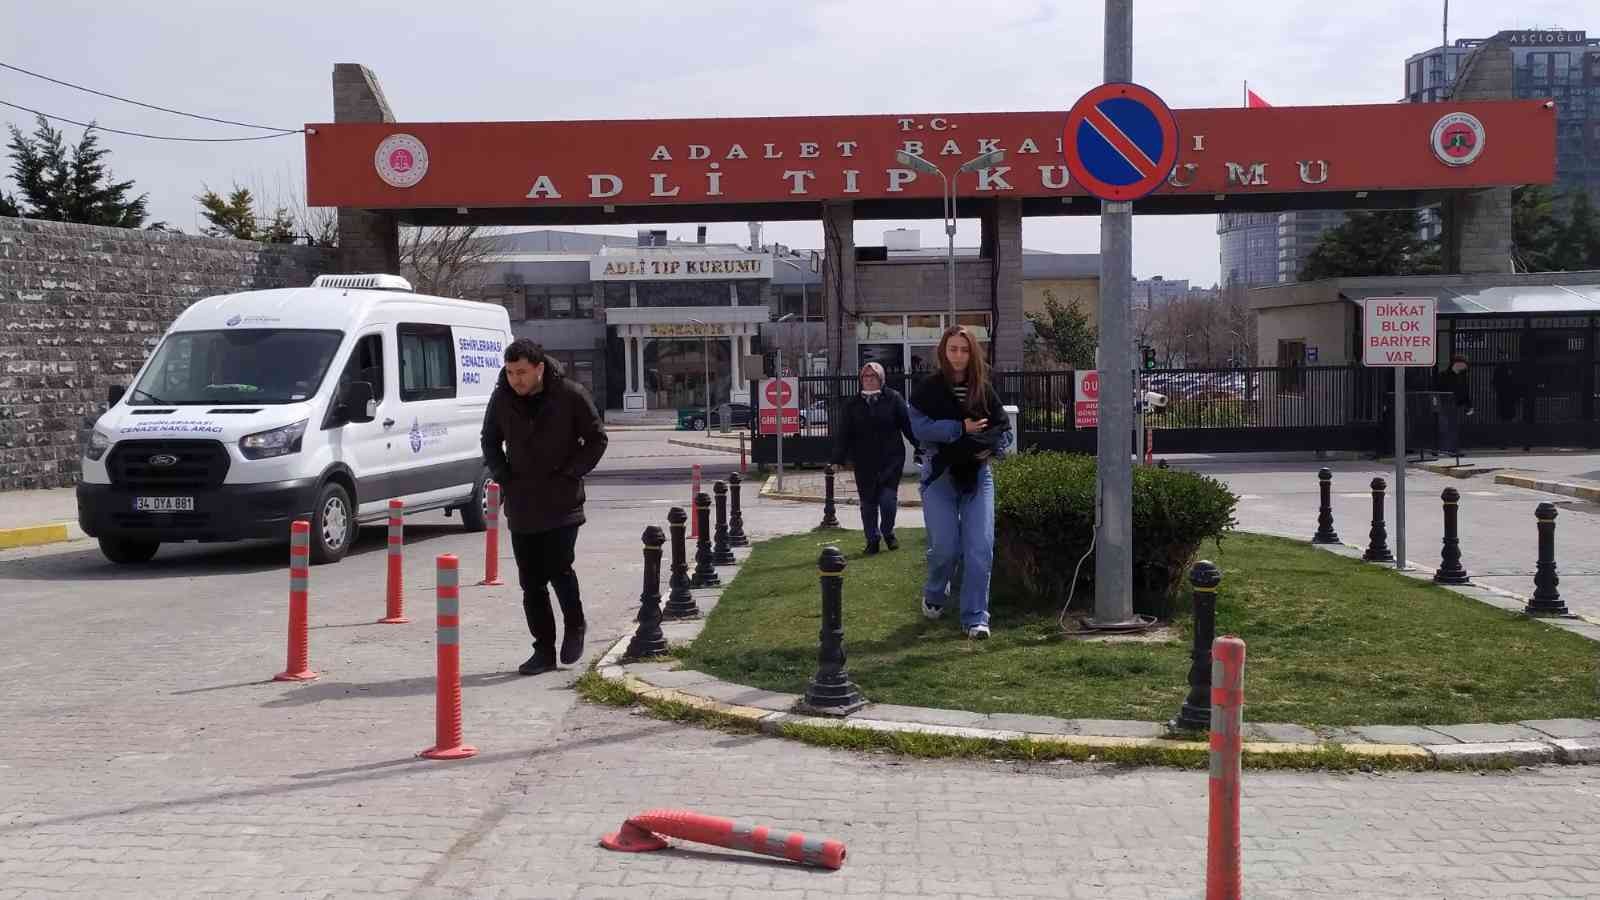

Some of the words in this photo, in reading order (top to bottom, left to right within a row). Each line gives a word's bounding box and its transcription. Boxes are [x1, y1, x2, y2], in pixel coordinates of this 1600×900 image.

[898, 118, 958, 131] T.C.
[651, 141, 857, 161] ADALET
[903, 135, 1205, 156] BAKAI
[525, 162, 724, 198] ADLİ
[783, 169, 917, 194] TIP
[975, 160, 1329, 191] KUUMU
[604, 259, 646, 275] ADLİ
[651, 260, 681, 275] TIP
[687, 259, 761, 275] KURUMU
[1376, 304, 1425, 317] DİKKAT
[1382, 321, 1420, 332] BLOK
[461, 354, 485, 368] CENAZE
[1386, 351, 1417, 362] VAR.
[138, 498, 149, 509] 34
